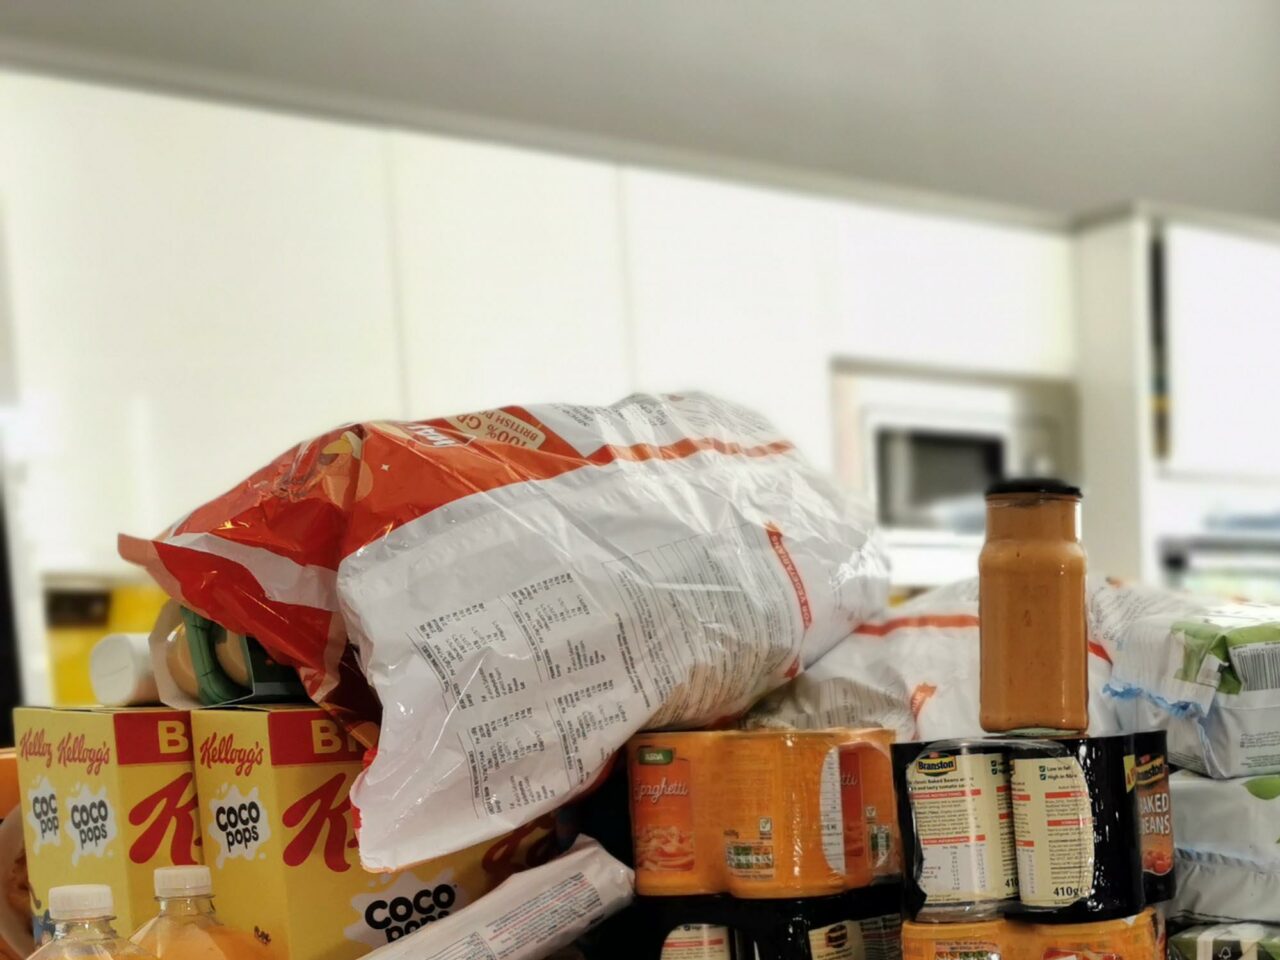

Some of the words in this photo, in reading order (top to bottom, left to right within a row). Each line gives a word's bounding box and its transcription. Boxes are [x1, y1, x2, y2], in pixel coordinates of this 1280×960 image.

[57, 732, 109, 775] Kellogg's
[200, 732, 264, 776] Kellogg's
[918, 760, 954, 770] Branston
[79, 822, 108, 849] pops
[225, 825, 260, 852] pops
[1053, 886, 1079, 897] 410g
